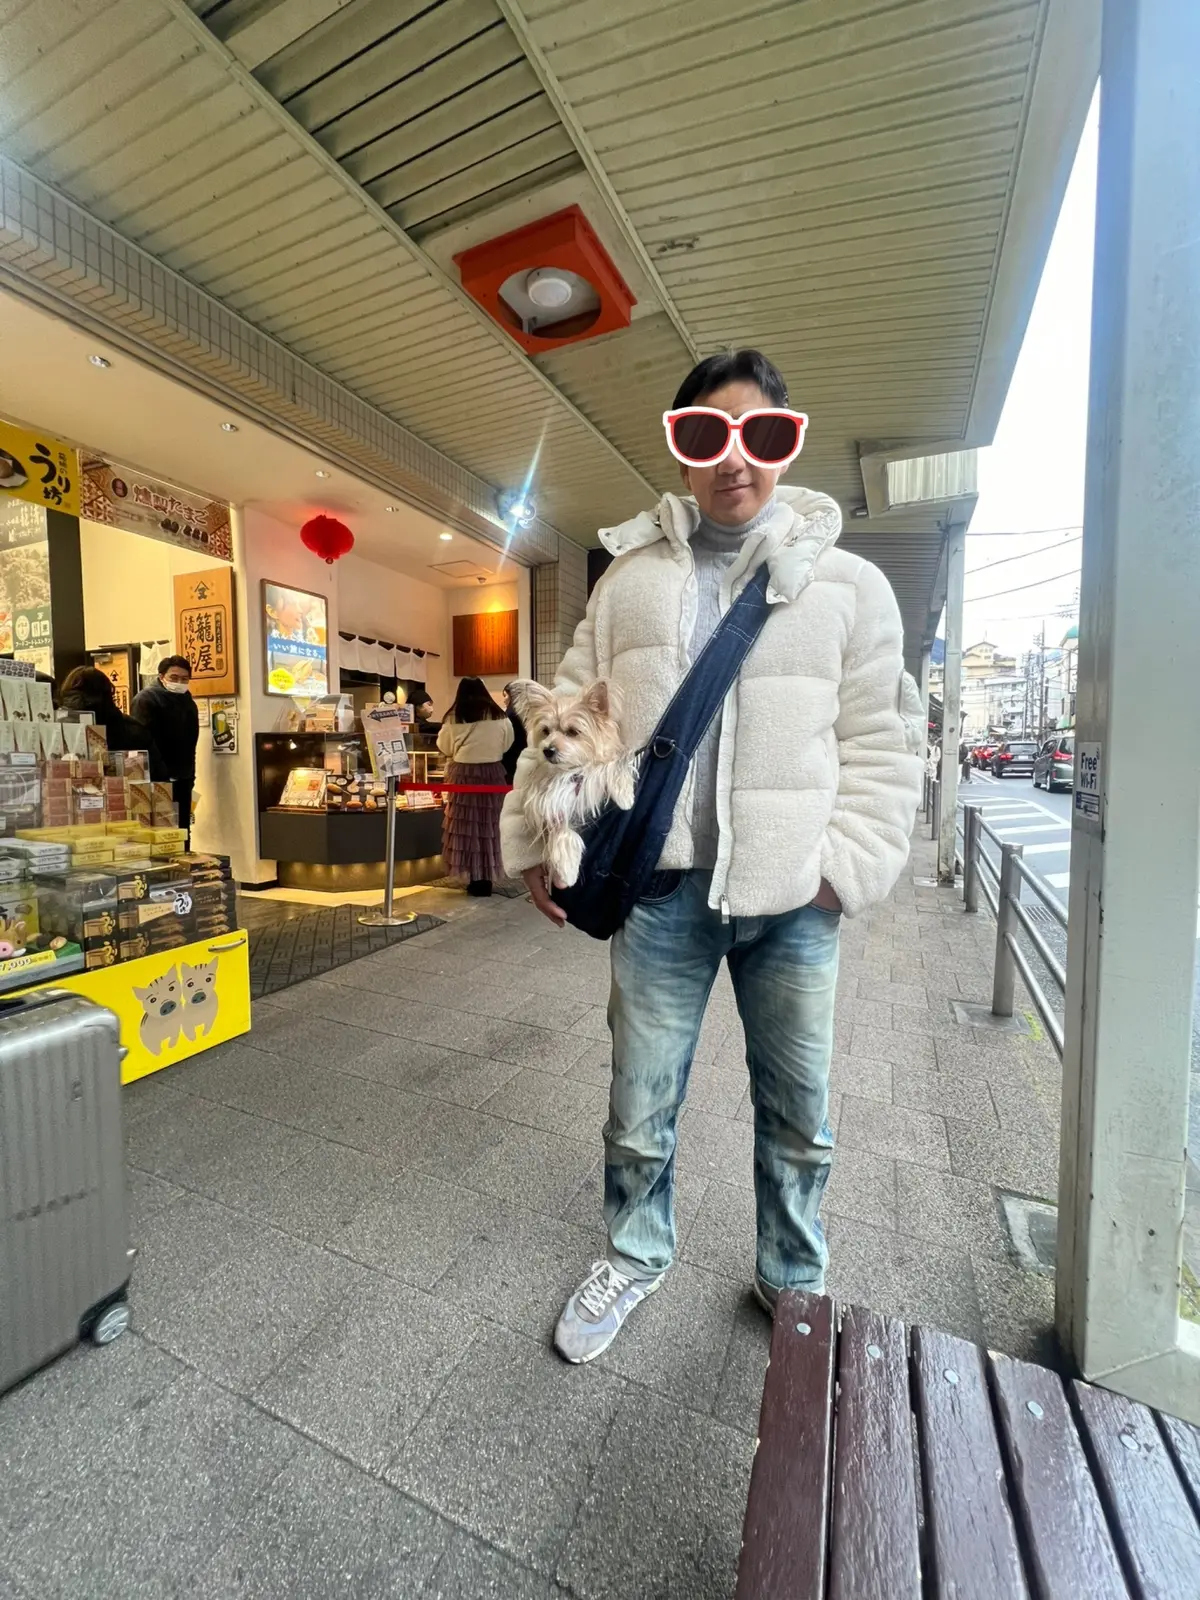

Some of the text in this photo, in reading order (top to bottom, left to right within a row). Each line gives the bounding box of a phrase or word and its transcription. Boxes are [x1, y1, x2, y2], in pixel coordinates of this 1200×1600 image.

[29, 442, 71, 505] うり坊
[194, 612, 216, 672] 籠屋
[377, 739, 405, 757] 入口
[1080, 752, 1098, 771] Free
[1080, 771, 1097, 790] Wi-Fi
